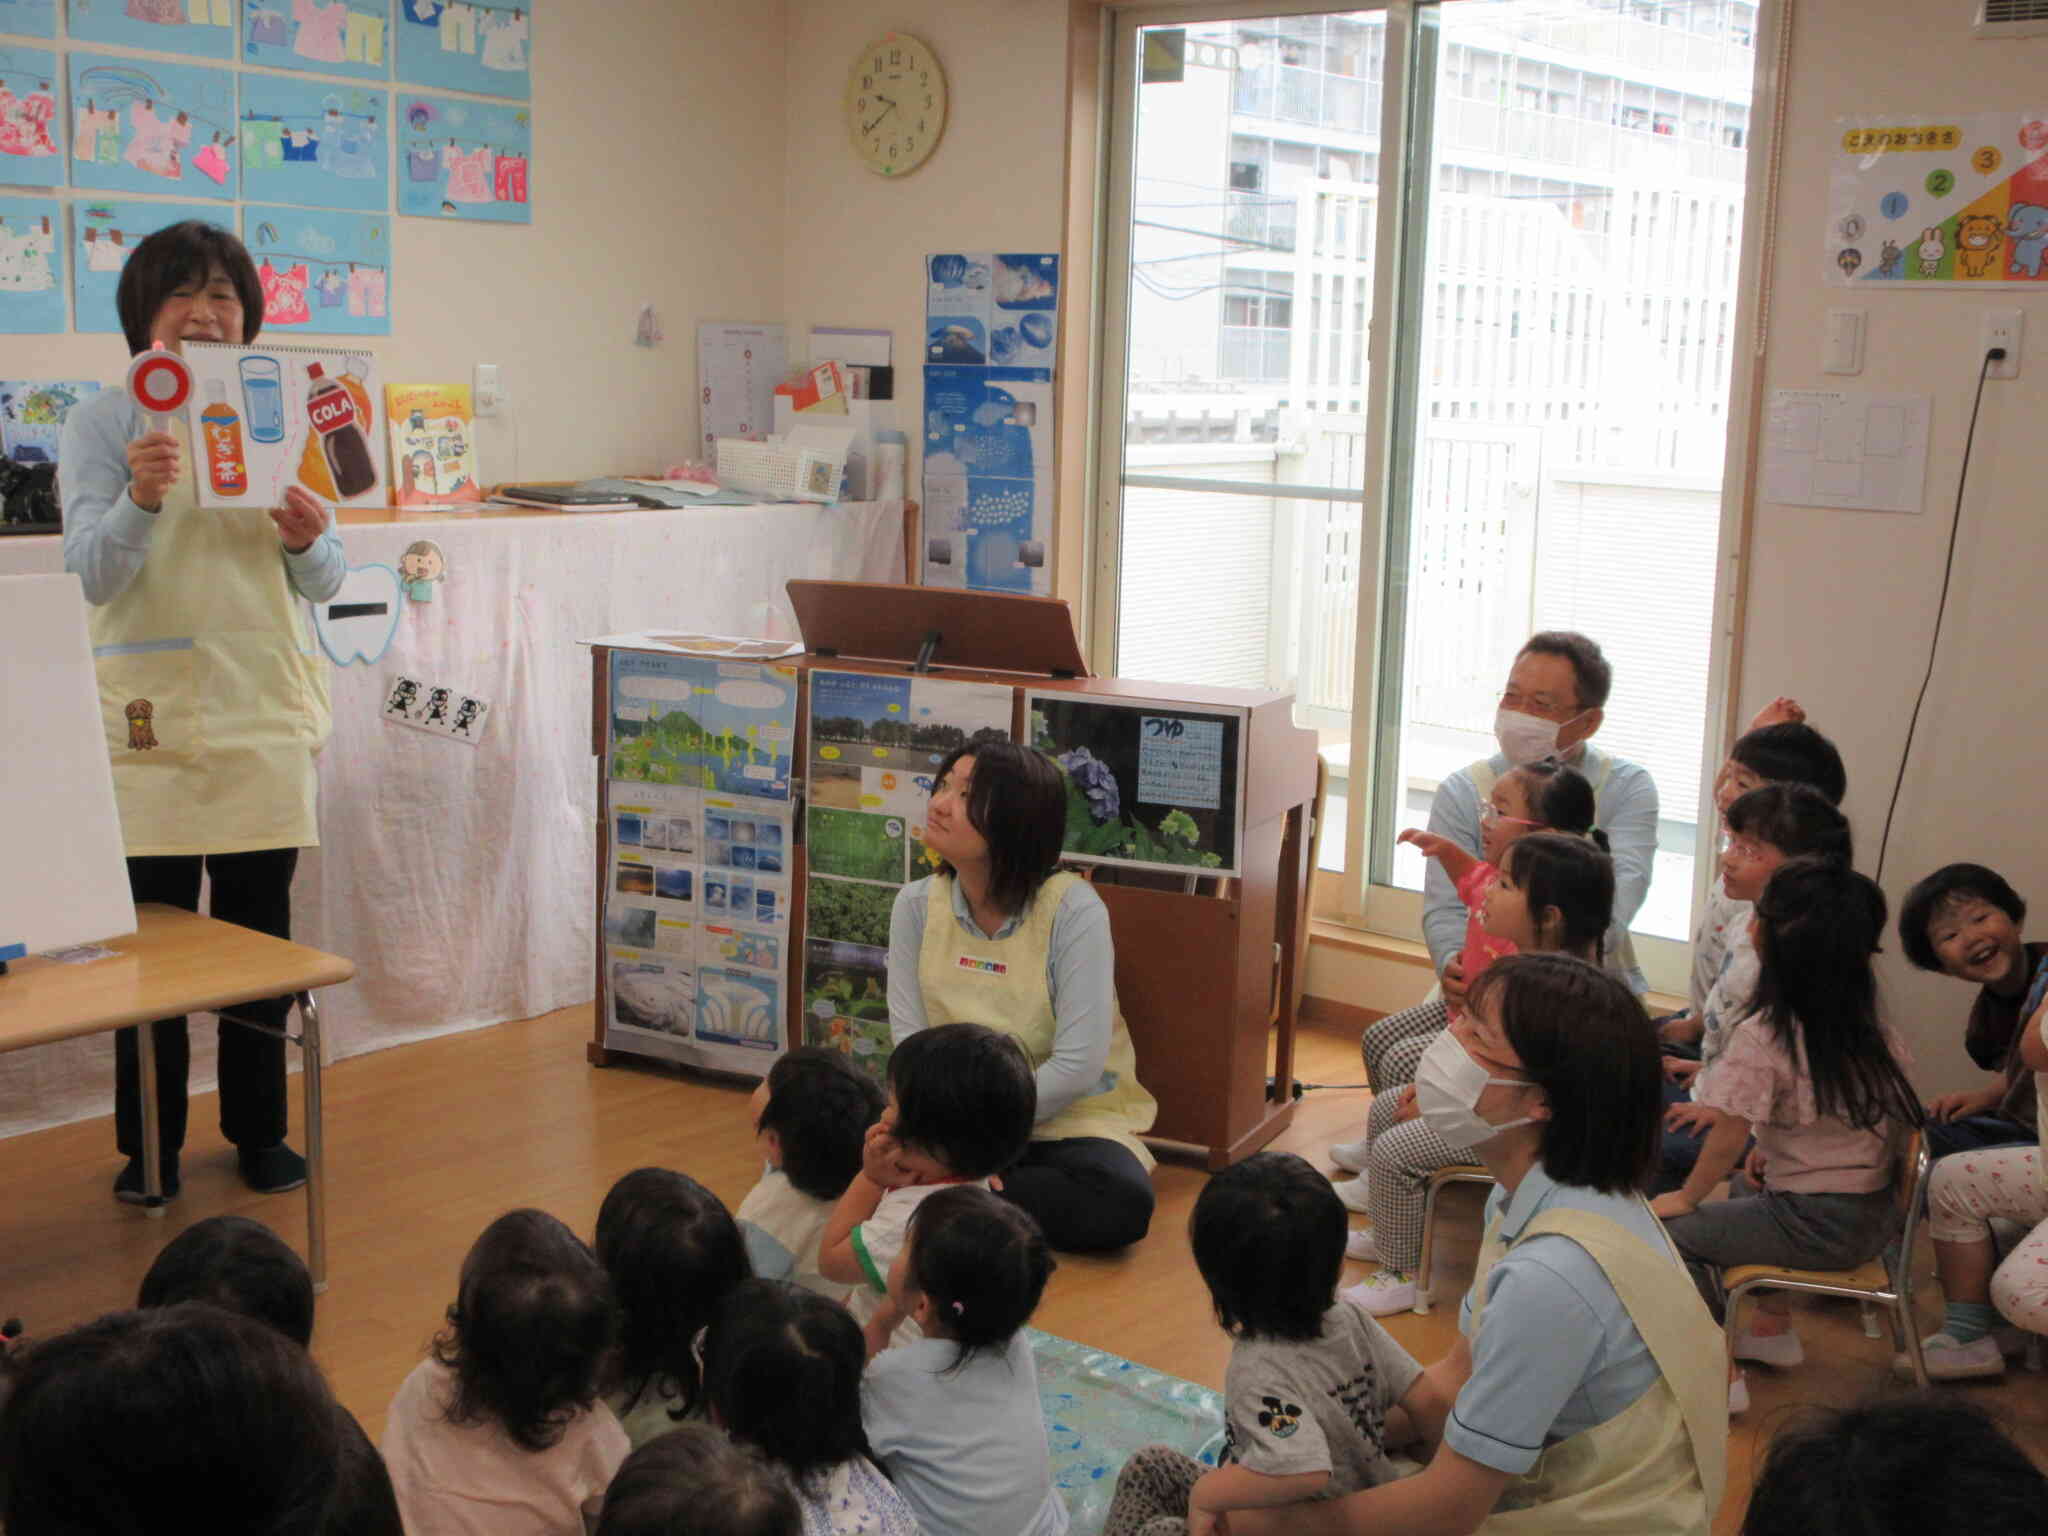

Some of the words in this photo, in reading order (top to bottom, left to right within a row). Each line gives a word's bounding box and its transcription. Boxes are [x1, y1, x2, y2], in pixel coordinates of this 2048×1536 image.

[889, 48, 902, 65] 12
[862, 75, 873, 91] 10
[919, 72, 929, 88] 2
[857, 97, 866, 113] 9
[925, 94, 933, 110] 3
[917, 119, 926, 134] 4
[873, 137, 881, 153] 7
[888, 143, 897, 159] 6
[904, 136, 914, 153] 5
[1980, 150, 1994, 169] 3
[1932, 175, 1946, 193] 2
[1889, 197, 1898, 215] 1
[1845, 219, 1859, 237] 0
[312, 398, 352, 425] COLA
[1144, 718, 1185, 740] つゆ
